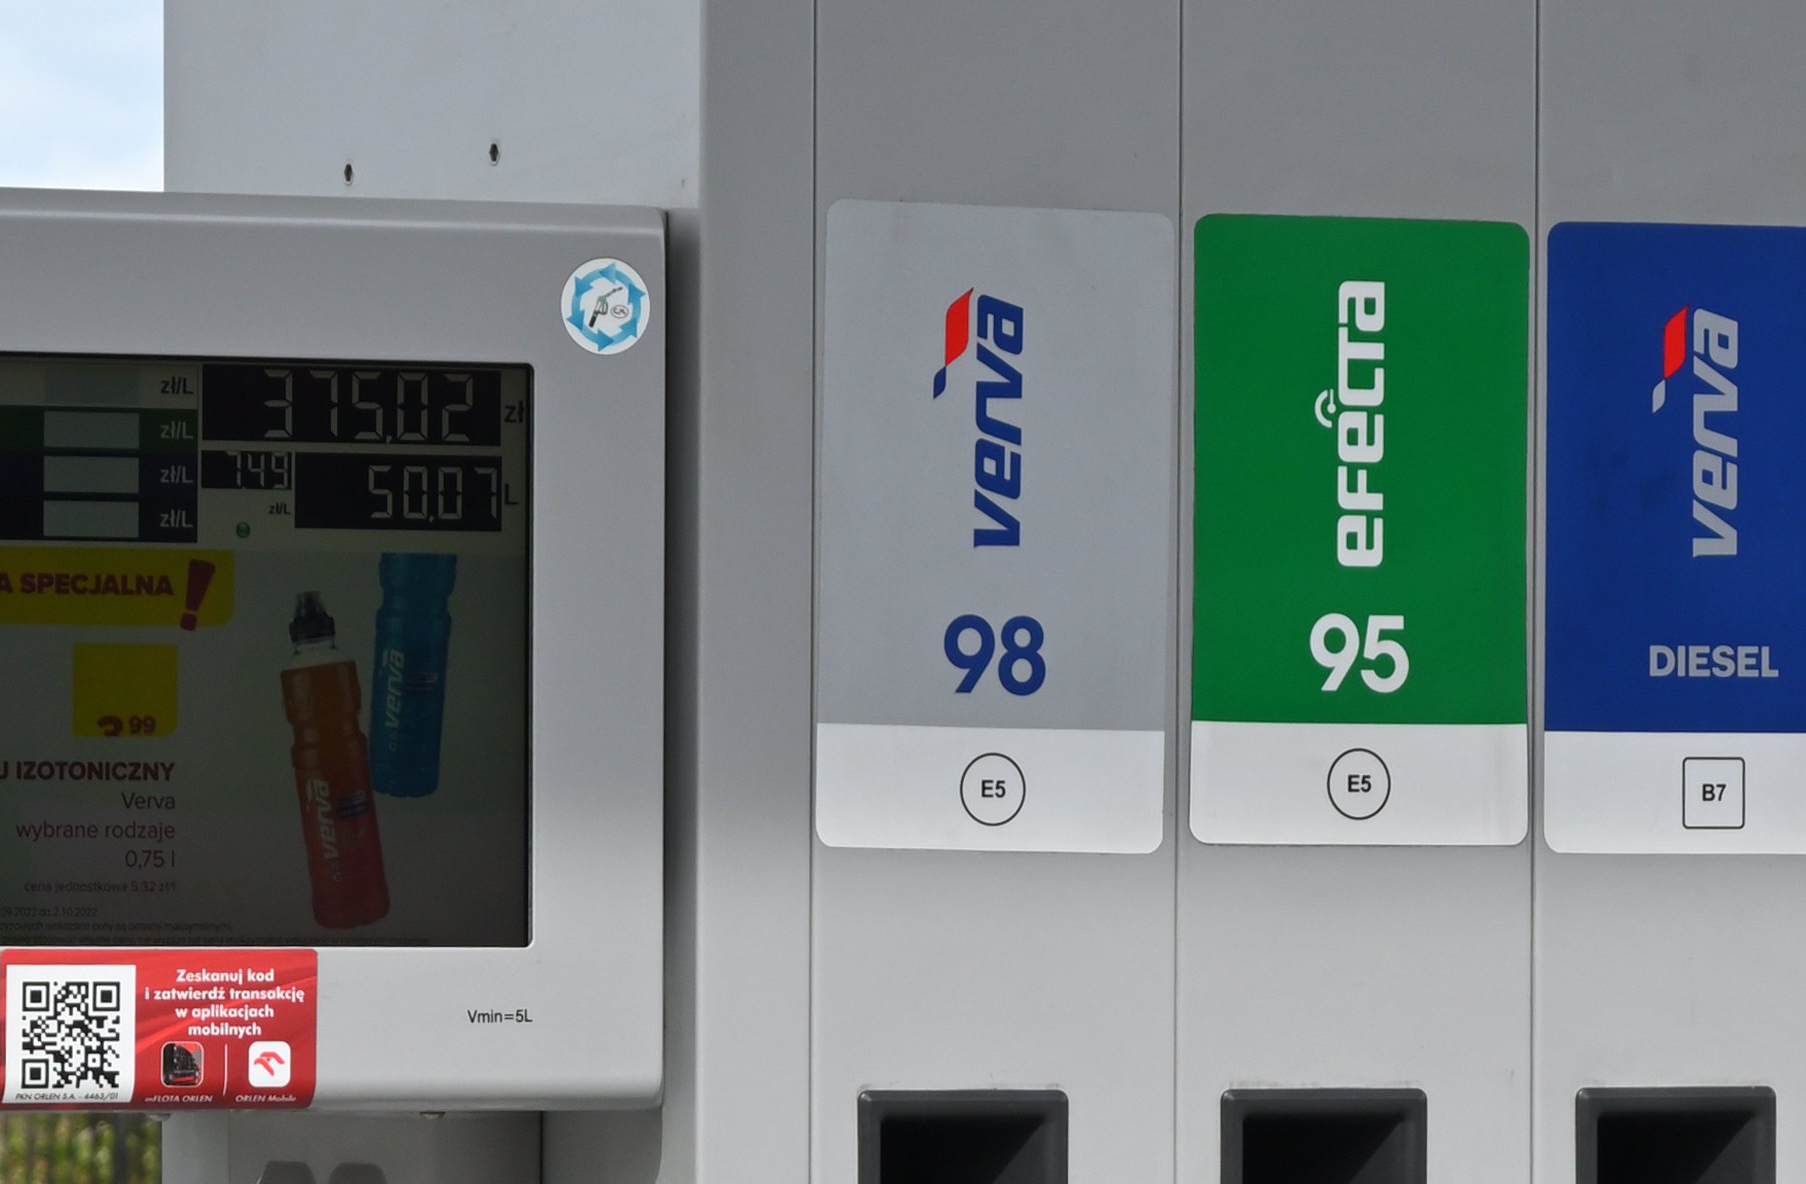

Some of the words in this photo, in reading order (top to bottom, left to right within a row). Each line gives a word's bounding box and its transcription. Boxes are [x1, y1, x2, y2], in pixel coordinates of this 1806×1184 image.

[504, 403, 525, 424] zł
[973, 293, 1024, 549] verva
[1692, 307, 1739, 558] verva
[504, 484, 518, 506] L
[21, 573, 173, 597] SPECJALNA
[944, 614, 1047, 697] 98
[1309, 612, 1409, 693] 95
[1648, 645, 1779, 678] DIESEL
[16, 760, 176, 783] IZOTONICZNY
[980, 779, 1007, 799] E5
[1347, 774, 1372, 794] E5
[1701, 783, 1726, 803] B7
[121, 791, 176, 811] Verva
[15, 819, 98, 843] wybrane
[103, 820, 176, 843] rodzaje
[125, 849, 166, 872] 0,75
[176, 968, 243, 985] Zeskanuj
[247, 968, 274, 983] kod
[144, 987, 149, 1000] i
[153, 986, 225, 1001] zatwierdź
[230, 987, 305, 1003] transakcję
[175, 1008, 187, 1019] w
[191, 1004, 274, 1021] aplikacjach
[467, 1009, 533, 1024] Vmin=5L
[188, 1022, 262, 1039] mobilnych
